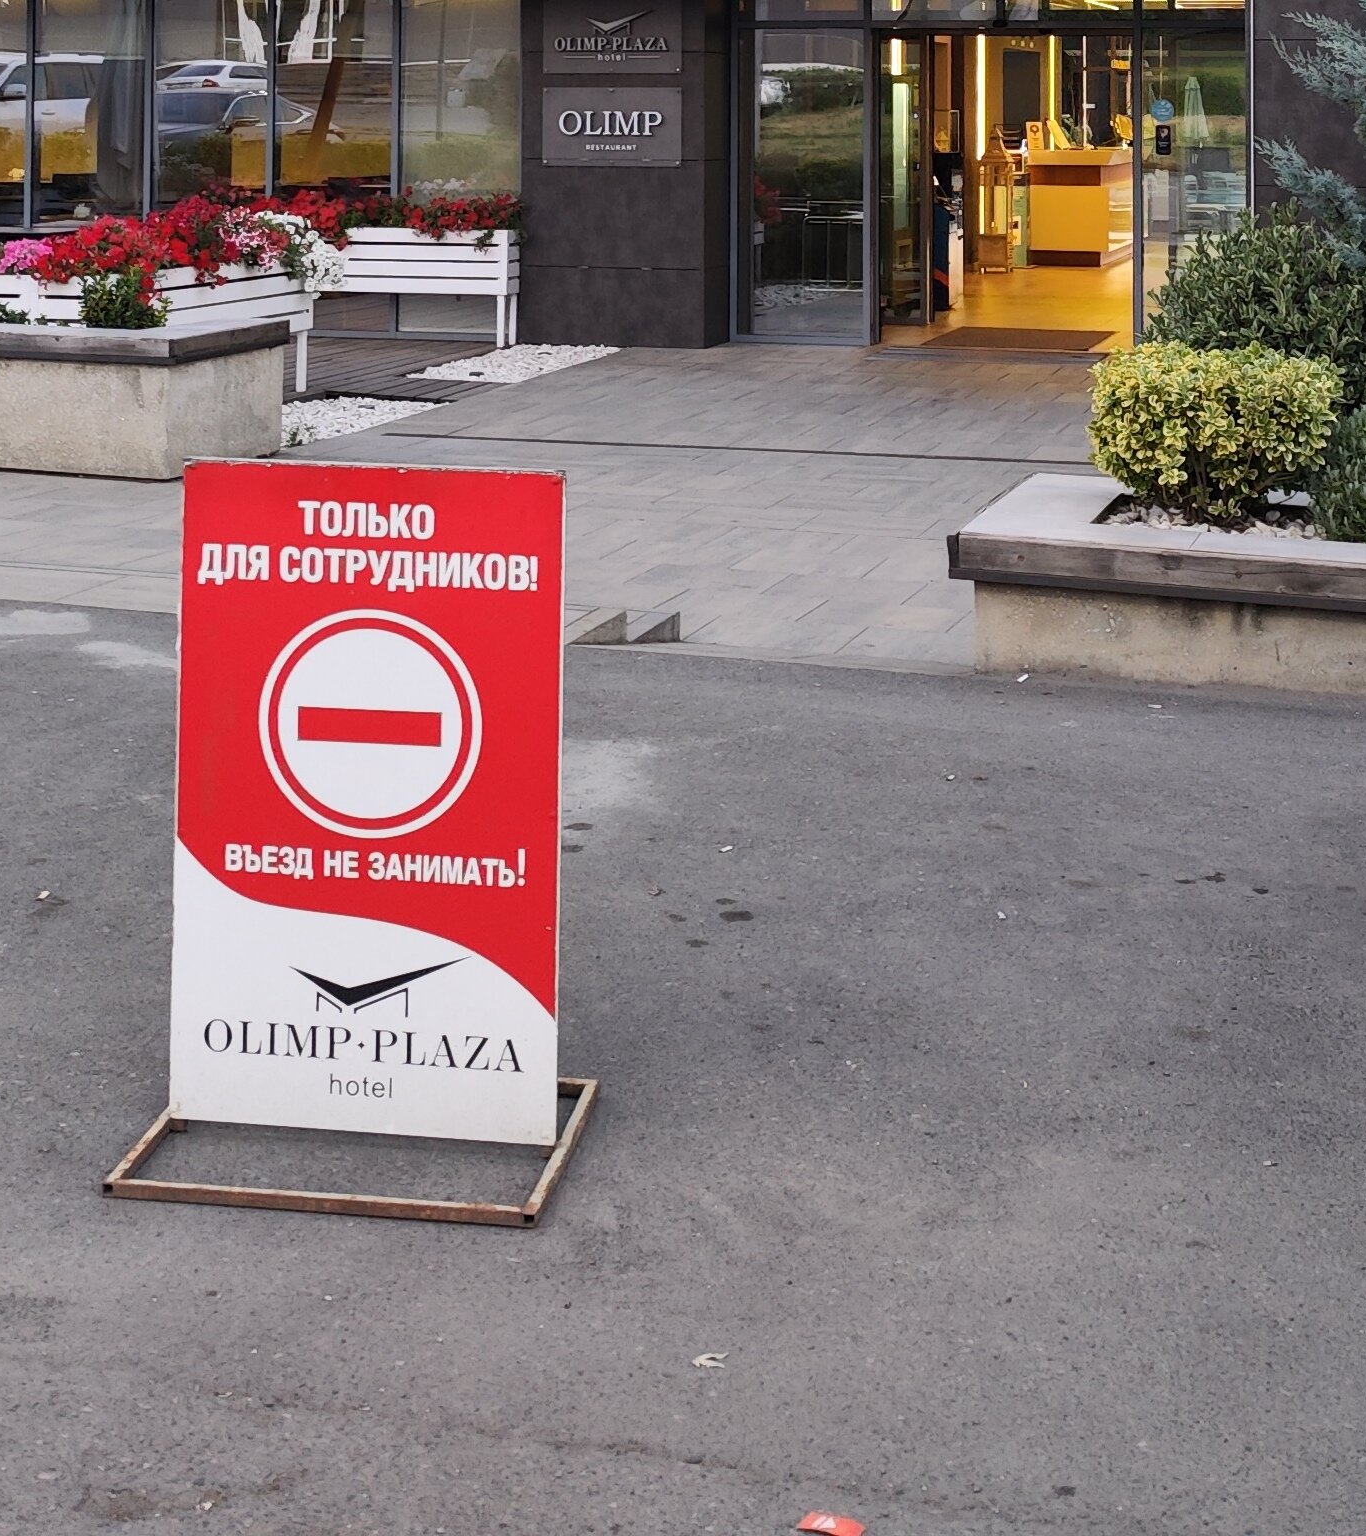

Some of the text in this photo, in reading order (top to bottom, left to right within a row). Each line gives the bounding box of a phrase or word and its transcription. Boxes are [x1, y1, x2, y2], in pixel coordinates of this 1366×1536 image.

[553, 36, 669, 52] OLIMP-PLAZA
[597, 53, 626, 62] hotel
[558, 109, 663, 136] OLIMP
[585, 143, 637, 152] RESTAURANT
[298, 500, 435, 539] ТОЛЬКО
[197, 543, 539, 592] ДЛЯ СОТРУДНИКОВ!
[225, 844, 526, 888] ВЪЕЗД НЕ ЗАНИМАТЬ!
[329, 1073, 393, 1098] hotel
